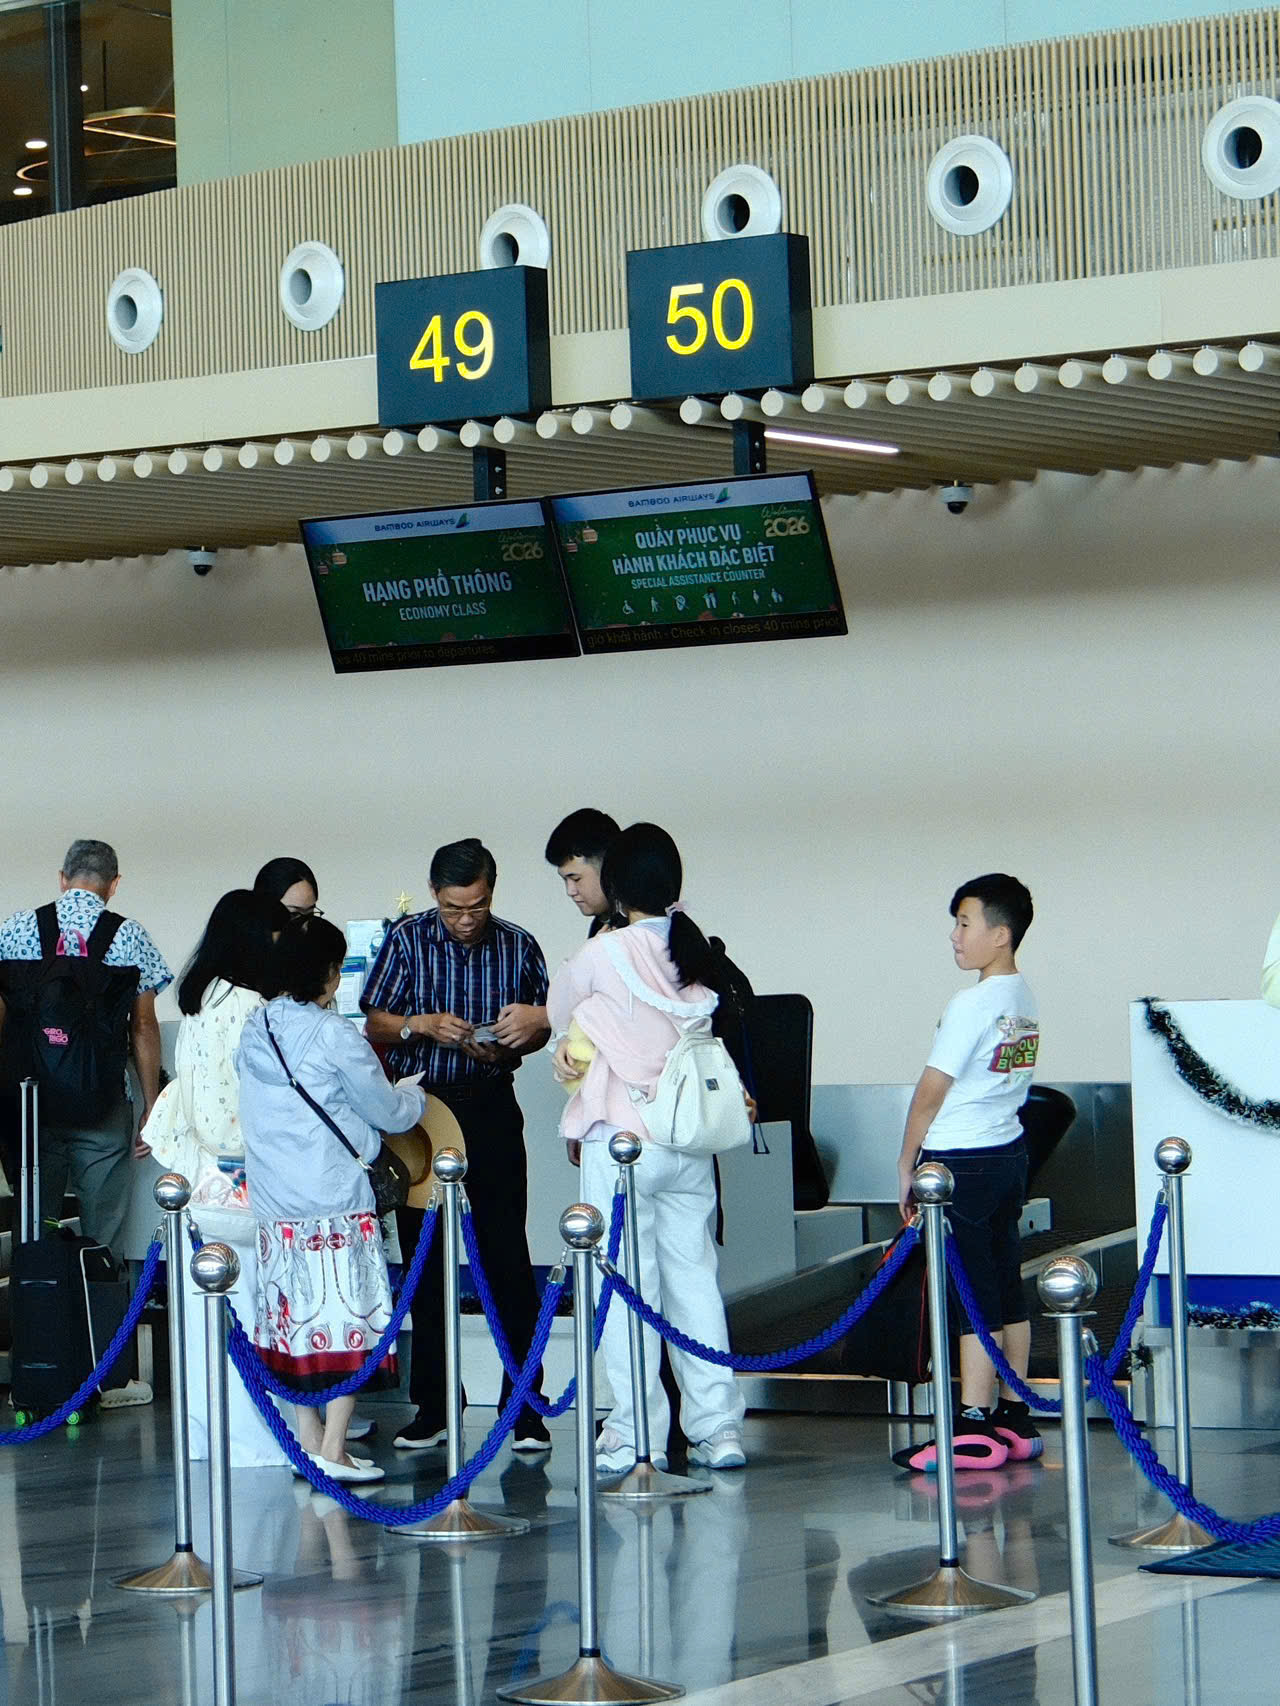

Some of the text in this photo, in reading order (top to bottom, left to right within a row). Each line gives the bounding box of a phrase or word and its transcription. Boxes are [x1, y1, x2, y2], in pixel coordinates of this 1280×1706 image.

[666, 278, 755, 356] 50
[409, 310, 493, 383] 49
[628, 492, 715, 508] BAMBOO AIRWAYS
[374, 517, 455, 532] BAMBOO AIRWAYS
[635, 522, 741, 549] QUẦY PHỤC VỤ
[763, 516, 810, 538] 2026
[501, 542, 545, 562] 2026
[612, 549, 656, 576] HÀNH
[656, 545, 707, 572] KHÁCH
[743, 541, 775, 568] BIỆT
[362, 567, 513, 606] HẠNG PHỔ THÔNG
[631, 567, 766, 590] SPECIAL ASSISTANCE COUNTER
[399, 601, 488, 621] ECONOMY CLASS
